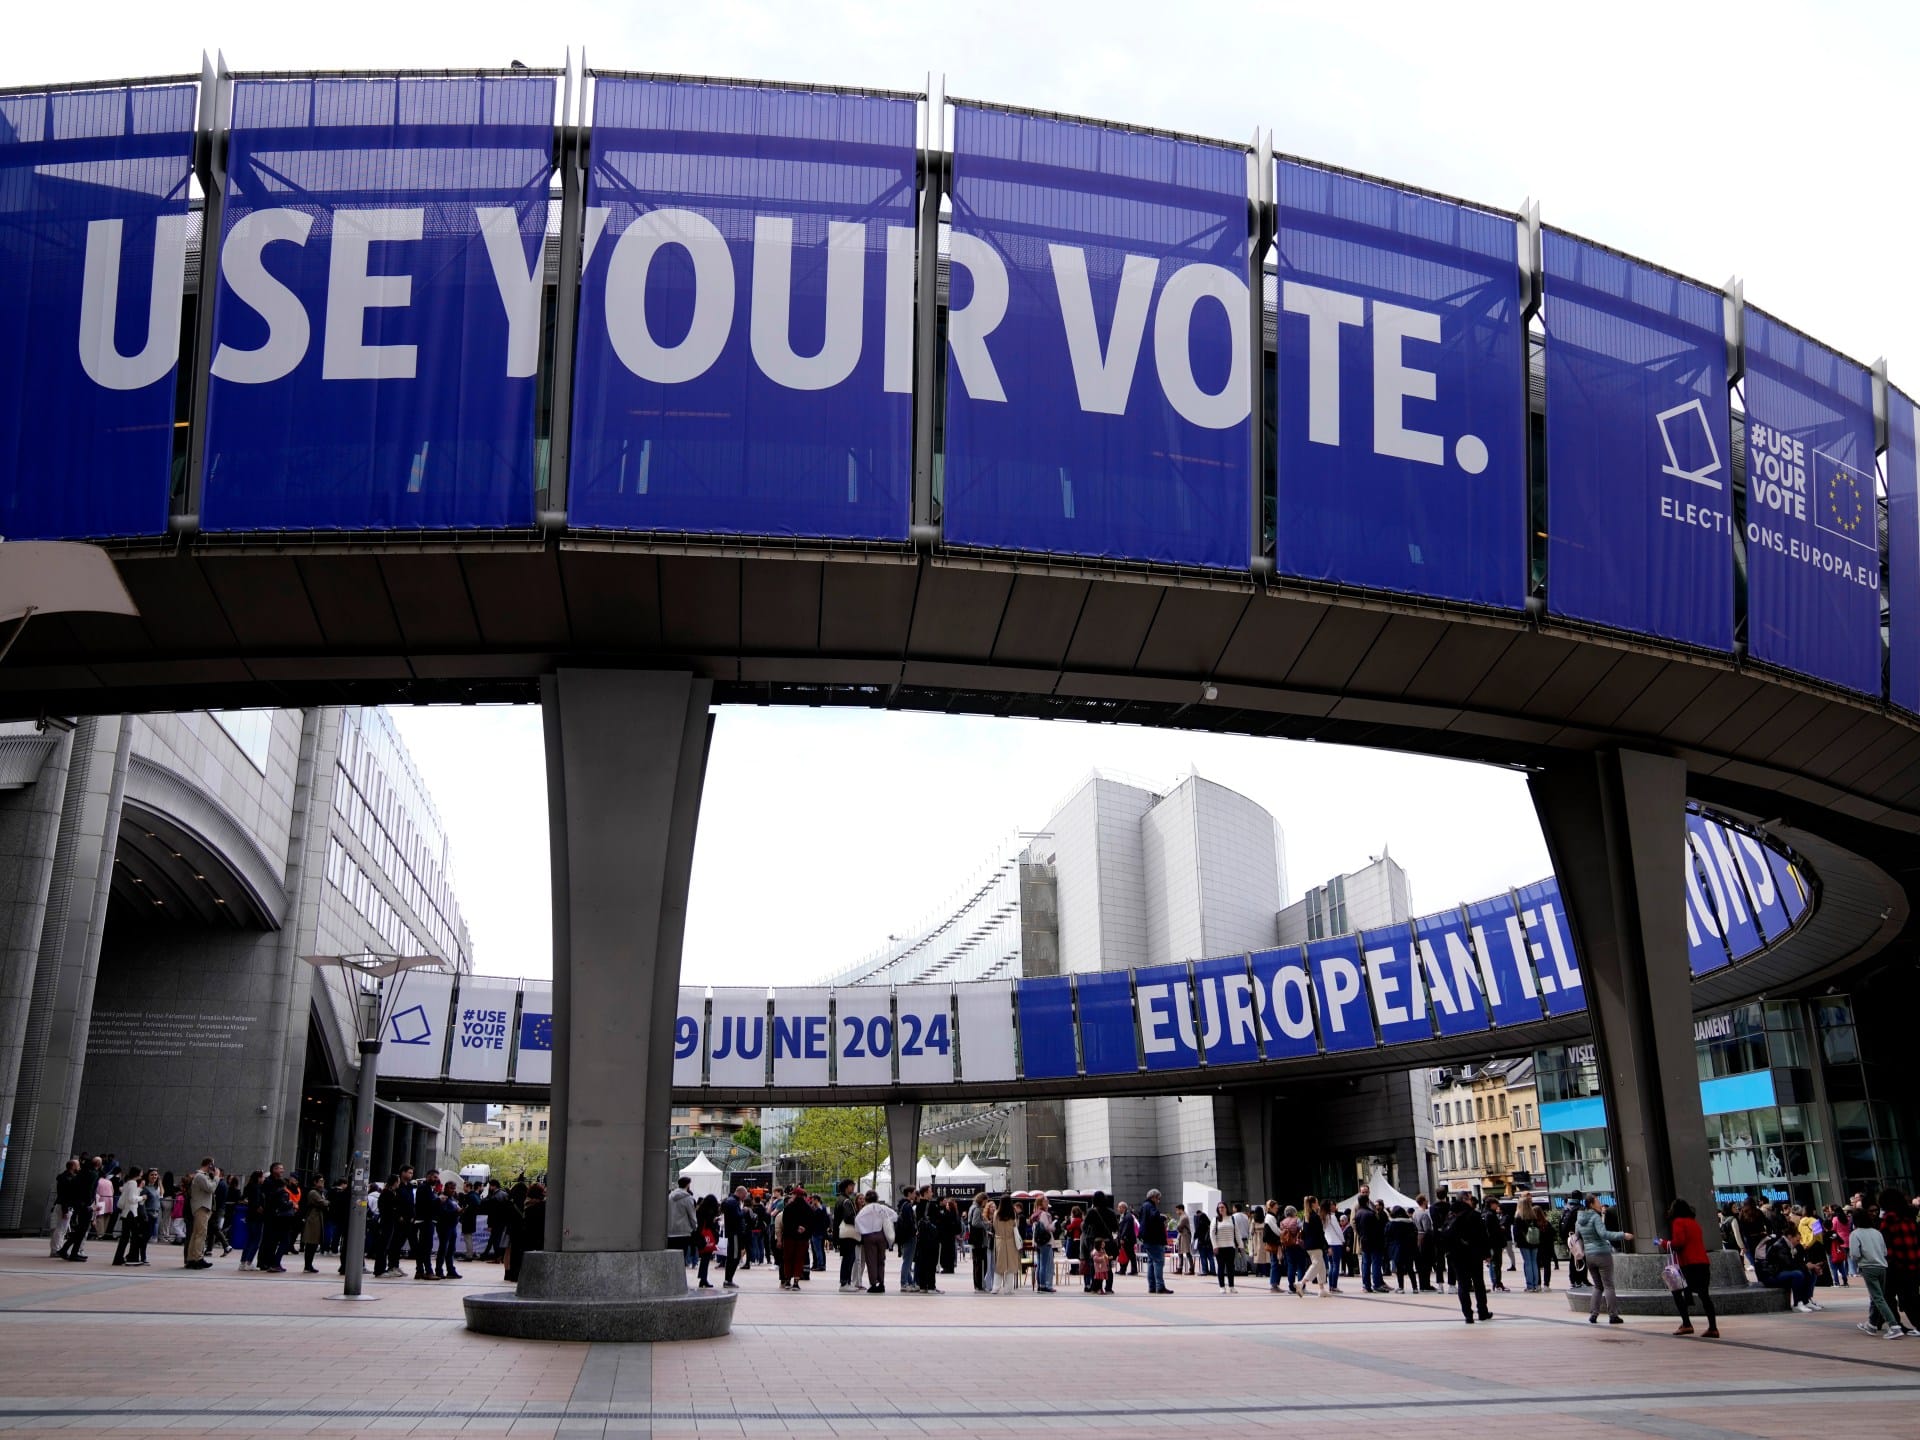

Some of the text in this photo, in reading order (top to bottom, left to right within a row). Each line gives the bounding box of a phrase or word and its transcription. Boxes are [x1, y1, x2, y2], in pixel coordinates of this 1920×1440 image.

[79, 206, 1489, 475] USE YOUR VOTE.
[1752, 423, 1805, 467] #USE
[1751, 448, 1806, 494] YOUR
[1752, 476, 1807, 521] VOTE
[1661, 496, 1879, 590] ELECTIONS.EUROPA.EU
[1136, 925, 1501, 1053] EUROPEAN
[463, 1009, 507, 1023] #USE
[463, 1022, 506, 1037] YOUR
[711, 1016, 827, 1060] JUNE
[843, 1013, 951, 1058] 2024
[1694, 1015, 1731, 1041] IAMENT
[461, 1035, 504, 1050] VOTE
[950, 1187, 976, 1195] TOILET
